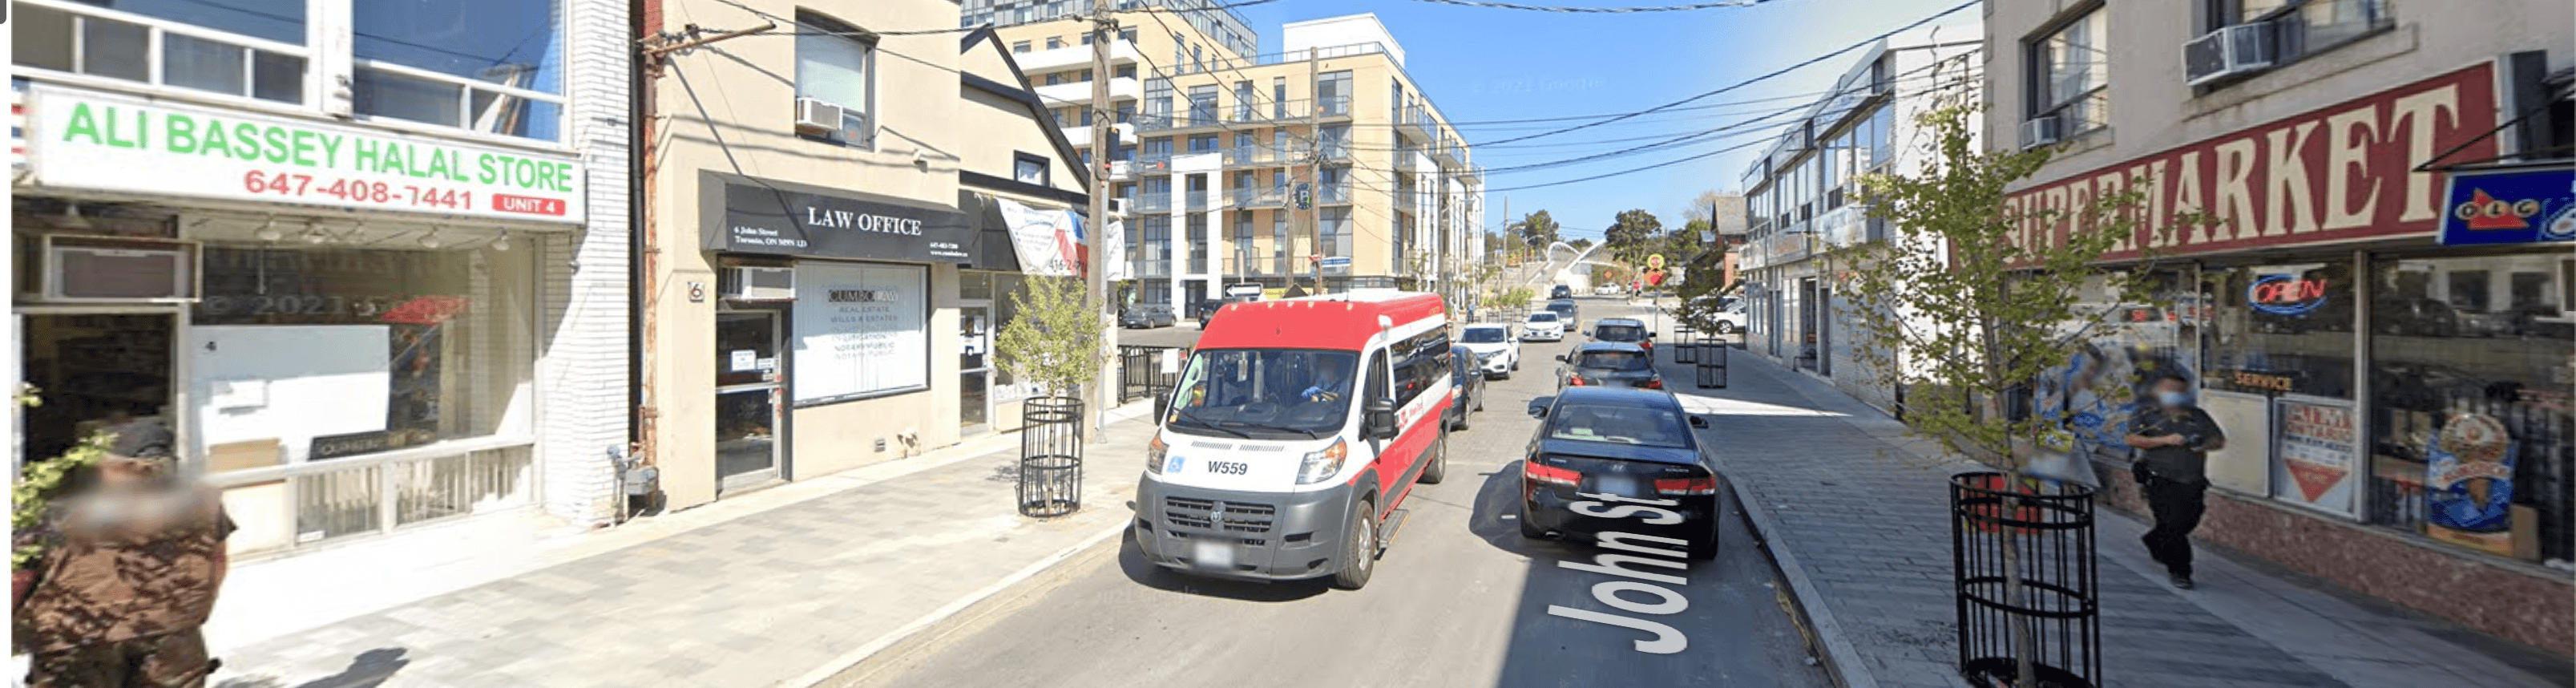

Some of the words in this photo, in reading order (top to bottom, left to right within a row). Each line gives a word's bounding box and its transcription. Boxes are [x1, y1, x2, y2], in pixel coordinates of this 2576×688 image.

[63, 102, 147, 150] ALI
[167, 113, 343, 168] BASSEY
[355, 137, 470, 182] HALAL
[479, 152, 573, 192] STORE
[2001, 83, 2459, 265] SUPERMARKET
[244, 169, 472, 210] 647-408-7441
[503, 196, 540, 212] UNIT
[545, 200, 555, 213] 4
[2458, 199, 2538, 219] OLG
[807, 206, 854, 229] LAW
[858, 213, 922, 236] OFFICE
[690, 284, 703, 297] 6
[2255, 279, 2328, 303] OPEN
[1208, 460, 1249, 476] W559
